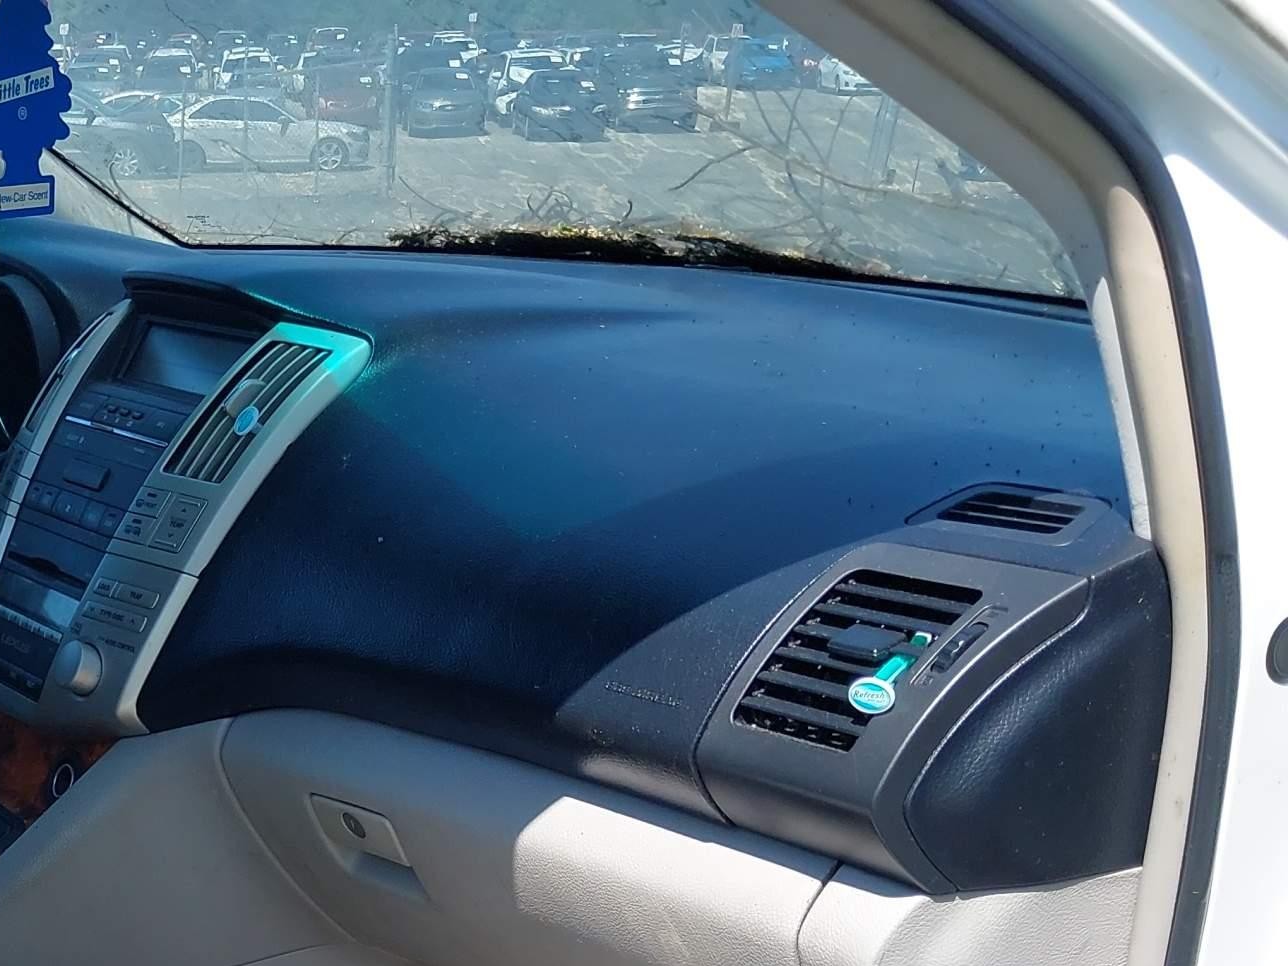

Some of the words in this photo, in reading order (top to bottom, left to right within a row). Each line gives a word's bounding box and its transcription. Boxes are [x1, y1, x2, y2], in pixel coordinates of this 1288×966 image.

[24, 74, 50, 94] Trees
[28, 189, 48, 201] Scent
[853, 689, 885, 699] Refresh
